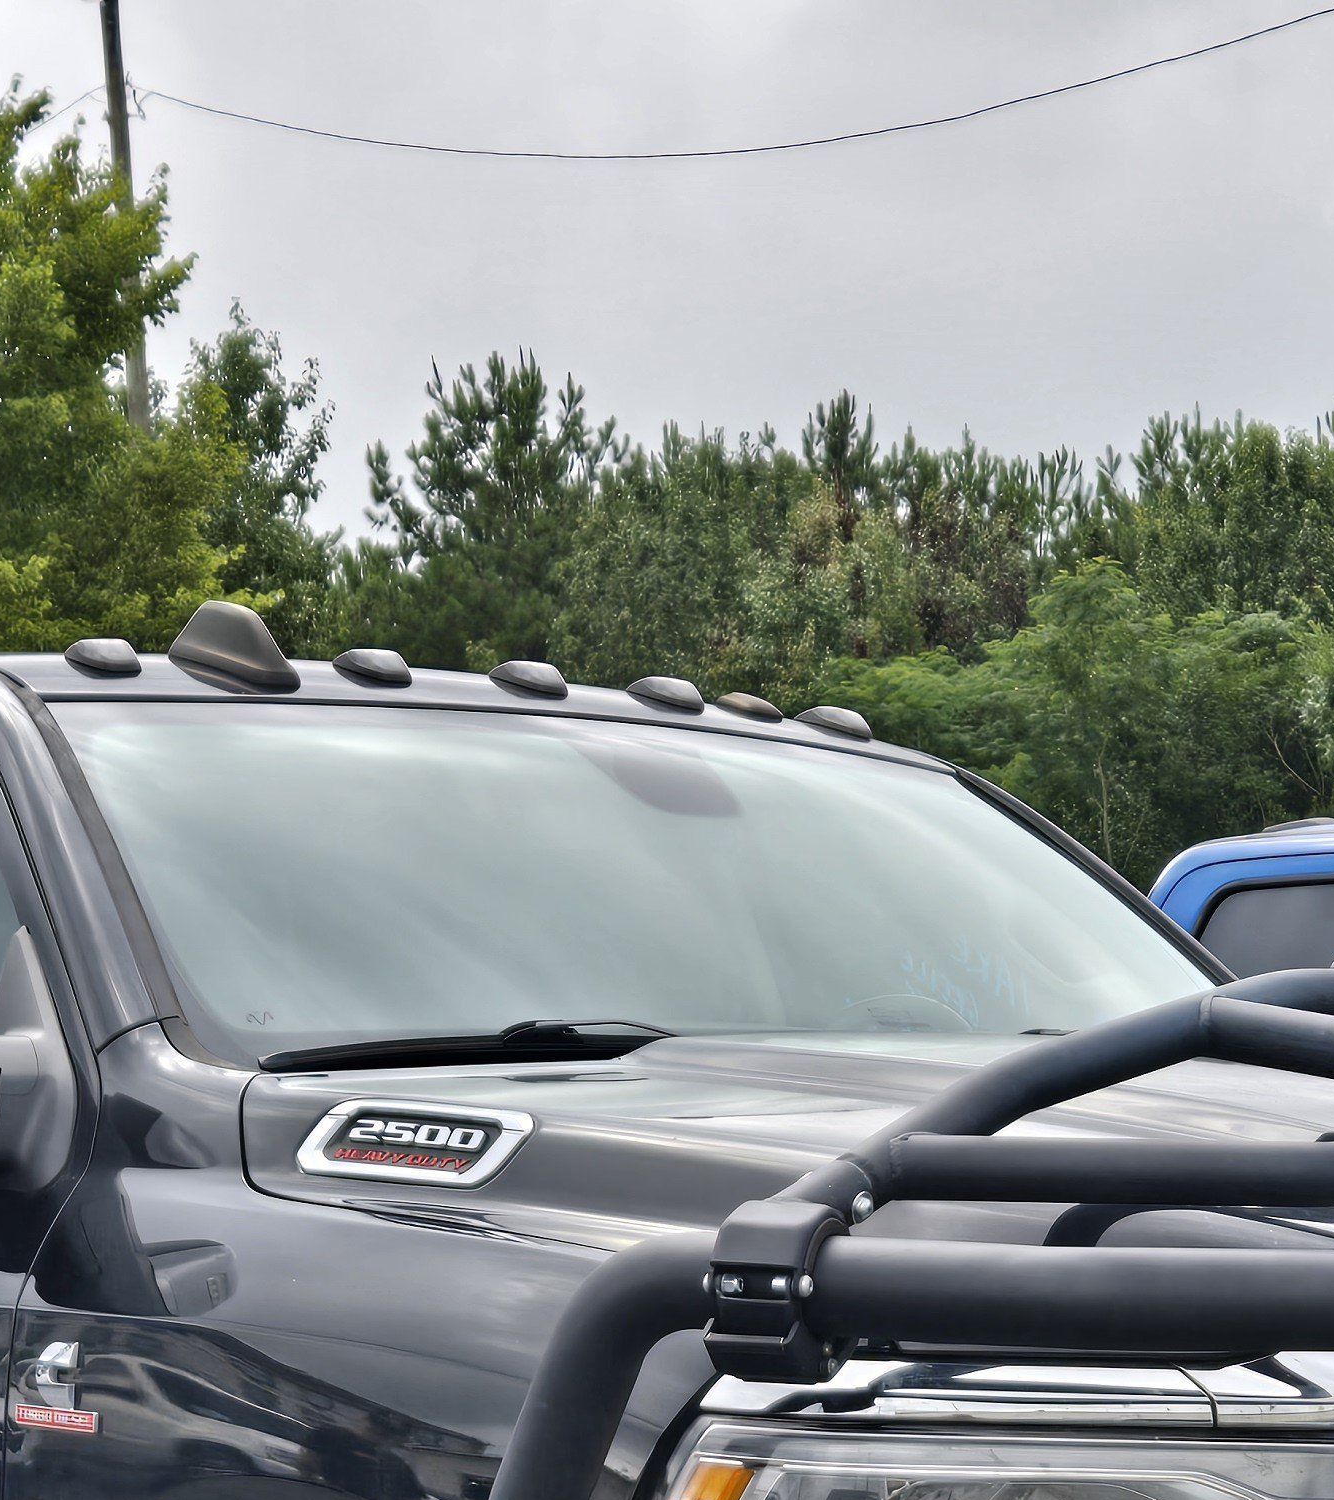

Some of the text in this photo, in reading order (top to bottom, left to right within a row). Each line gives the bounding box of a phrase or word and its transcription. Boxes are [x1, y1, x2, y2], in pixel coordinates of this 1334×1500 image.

[349, 1119, 487, 1151] 2500
[334, 1147, 471, 1170] HEAVY DUTY
